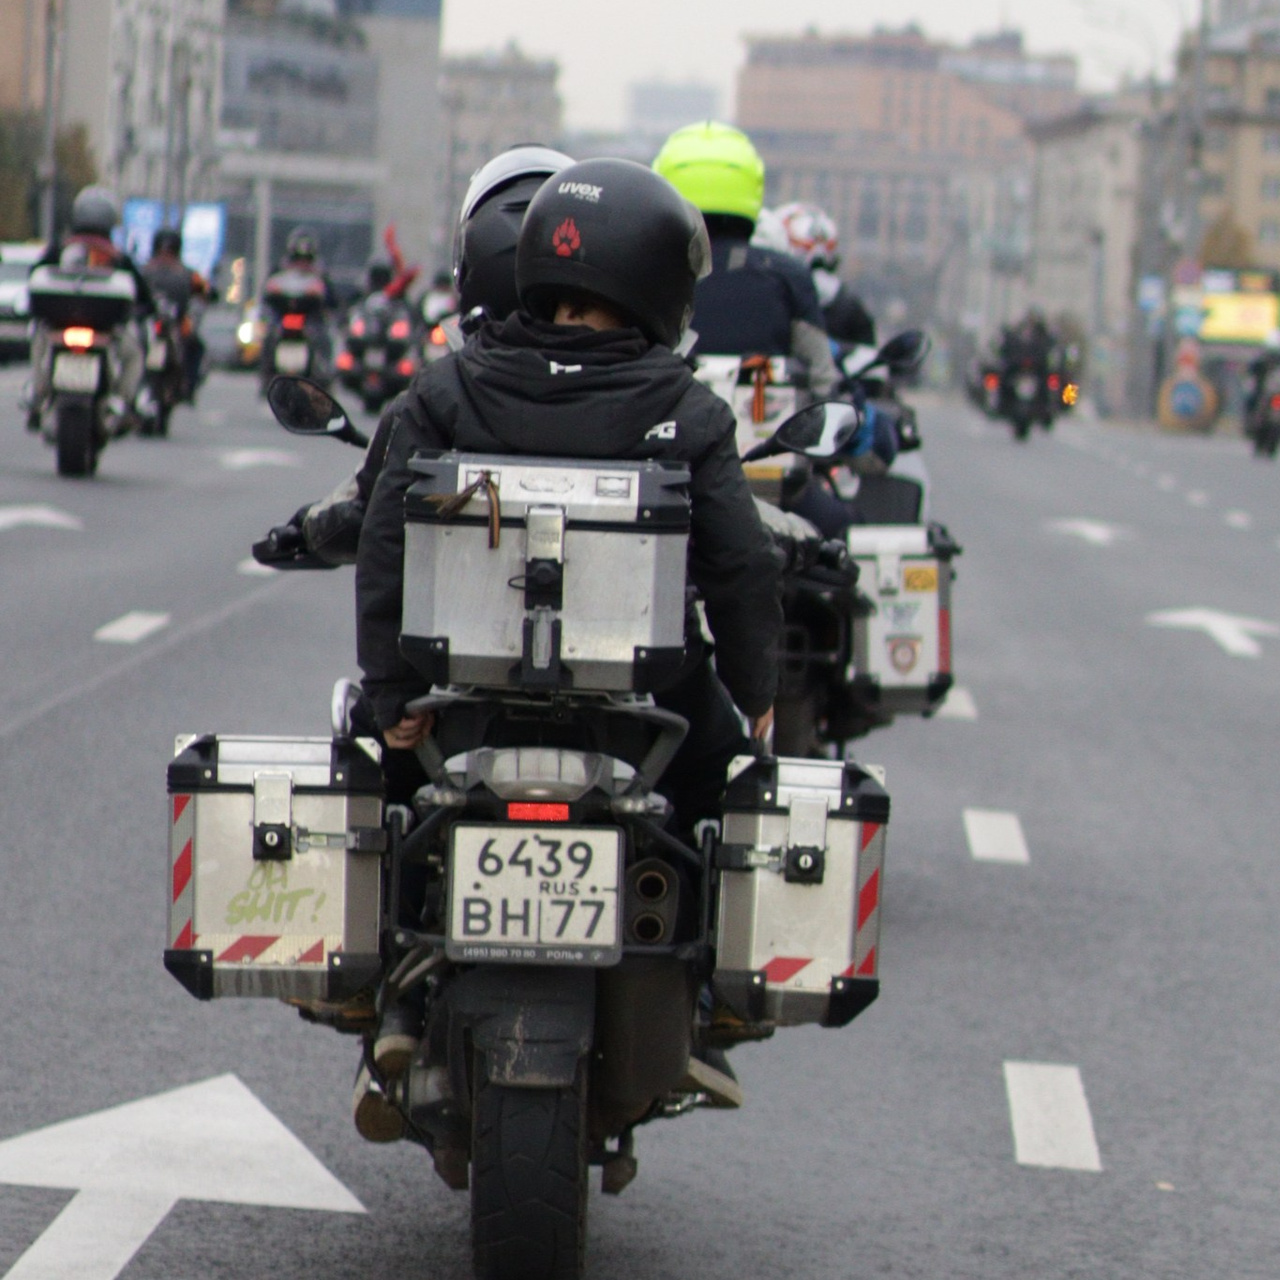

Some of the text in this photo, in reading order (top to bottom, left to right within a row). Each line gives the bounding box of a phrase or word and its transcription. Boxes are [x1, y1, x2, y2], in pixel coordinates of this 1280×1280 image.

[558, 181, 603, 198] uvex
[477, 837, 594, 879] 6439
[539, 881, 580, 896] RUS
[550, 900, 606, 939] 77
